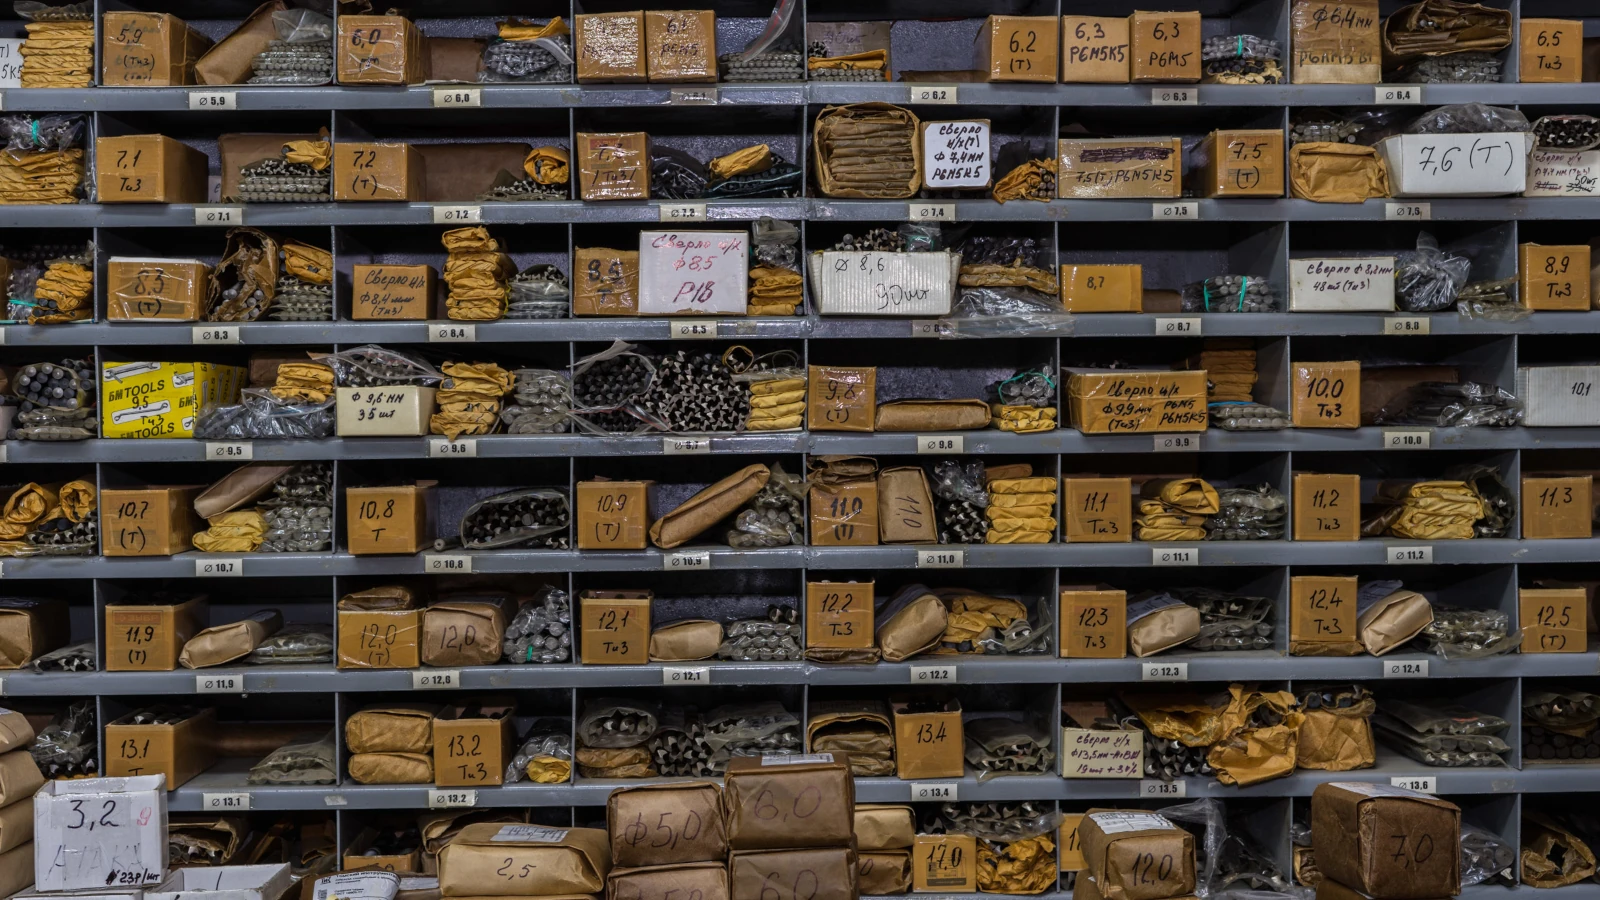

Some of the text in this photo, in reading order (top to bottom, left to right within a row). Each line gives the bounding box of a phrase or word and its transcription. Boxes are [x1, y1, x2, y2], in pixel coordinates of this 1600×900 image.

[117, 29, 142, 43] 5,9
[1075, 23, 1105, 42] 6,3
[1153, 21, 1180, 42] 6,3
[352, 29, 381, 49] 6,0
[1538, 31, 1562, 48] 6,5
[211, 97, 225, 105] 5,9
[455, 94, 469, 102] 6,0
[932, 91, 946, 101] 6,2
[1174, 92, 1187, 101] 6,3
[1397, 91, 1410, 100] 6,4
[1233, 143, 1267, 161] 7,5
[117, 150, 141, 169] 7,1
[353, 151, 376, 169] 7,2
[1419, 146, 1461, 175] 7,6
[218, 213, 229, 221] 7,1
[456, 211, 469, 219] 7,2
[932, 208, 944, 217] 7,4
[1174, 207, 1187, 215] 7,5
[859, 254, 884, 274] 8,6
[1545, 256, 1570, 276] 8,9
[134, 269, 164, 295] 8,3
[1087, 277, 1104, 290] 8,7
[451, 329, 464, 338] 8,4
[692, 326, 706, 334] 8,5
[1178, 323, 1190, 332] 8,7
[214, 332, 228, 340] 8,3
[1307, 378, 1344, 399] 10,0
[1571, 382, 1591, 396] 10,1
[939, 440, 953, 449] 9,8
[1176, 438, 1189, 447] 9,9
[1404, 436, 1422, 444] 10,0
[228, 447, 242, 456] 9,5
[451, 444, 466, 453] 9,6
[597, 494, 627, 512] 10,9
[1313, 490, 1339, 508] 11,2
[1540, 488, 1572, 507] 11,3
[118, 502, 148, 519] 10,7
[359, 499, 394, 519] 10,8
[831, 497, 863, 519] 11,0
[683, 558, 701, 566] 10,9
[938, 555, 954, 563] 11,0
[1173, 553, 1189, 562] 11,1
[1408, 551, 1424, 560] 11,2
[216, 564, 233, 572] 10,7
[445, 560, 463, 569] 10,8
[822, 594, 853, 614] 12,2
[1310, 588, 1342, 610] 12,4
[598, 611, 629, 631] 12,1
[1079, 608, 1108, 627] 12,3
[1538, 606, 1572, 627] 12,5
[126, 626, 154, 644] 11,9
[361, 624, 396, 649] 12,0
[440, 625, 476, 651] 12,0
[930, 671, 948, 679] 12,2
[1162, 668, 1179, 676] 12,3
[1402, 665, 1420, 674] 12,4
[683, 672, 700, 681] 12,1
[217, 680, 233, 689] 11,9
[917, 722, 947, 744] 13,4
[1159, 785, 1177, 794] 13,5
[1410, 781, 1428, 790] 13,6
[448, 795, 466, 803] 13,2
[930, 789, 949, 797] 13,4
[223, 798, 240, 806] 13,1
[755, 786, 821, 822] 6,0
[68, 800, 120, 831] 3,2
[927, 844, 961, 871] 17,0
[1391, 834, 1433, 868] 7,0
[497, 858, 536, 880] 2,5
[1132, 853, 1172, 886] 12,0
